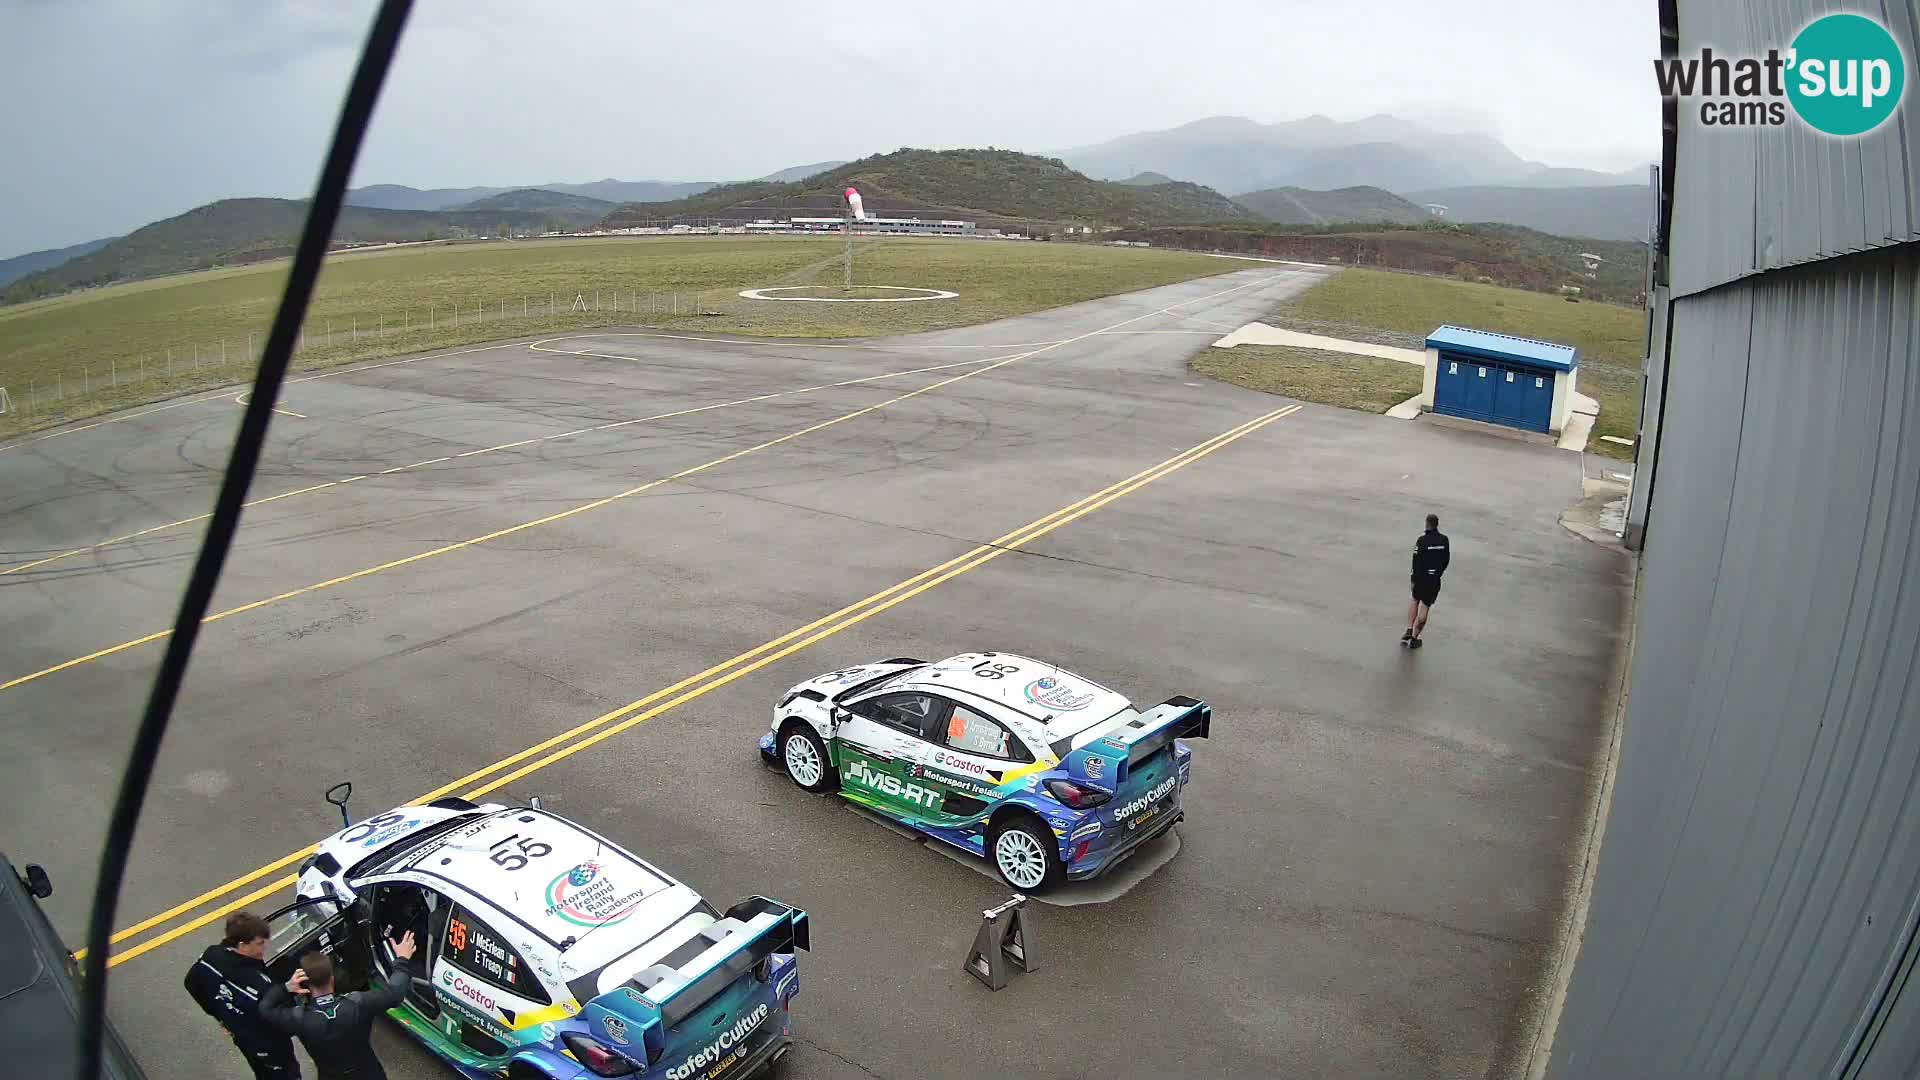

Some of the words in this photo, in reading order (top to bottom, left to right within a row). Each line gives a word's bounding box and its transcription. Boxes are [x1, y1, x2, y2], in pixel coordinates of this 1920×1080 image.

[945, 755, 985, 775] Castrol
[923, 769, 970, 791] Motorsport
[971, 783, 1004, 800] Ireland
[1113, 776, 1176, 822] SafetyCulture
[489, 837, 553, 871] 55
[544, 876, 610, 918] Motorsport
[573, 884, 615, 911] Ireland
[584, 895, 615, 914] Rally
[593, 888, 645, 919] Academy
[449, 918, 467, 951] 55
[469, 929, 476, 944] J
[475, 931, 505, 961] McErlean
[474, 950, 481, 964] E
[481, 952, 503, 979] Treacy
[453, 977, 496, 1012] Castrol
[435, 990, 485, 1027] Motorsport
[486, 1020, 521, 1047] Ireland
[664, 1002, 769, 1080] SafetyCulture
